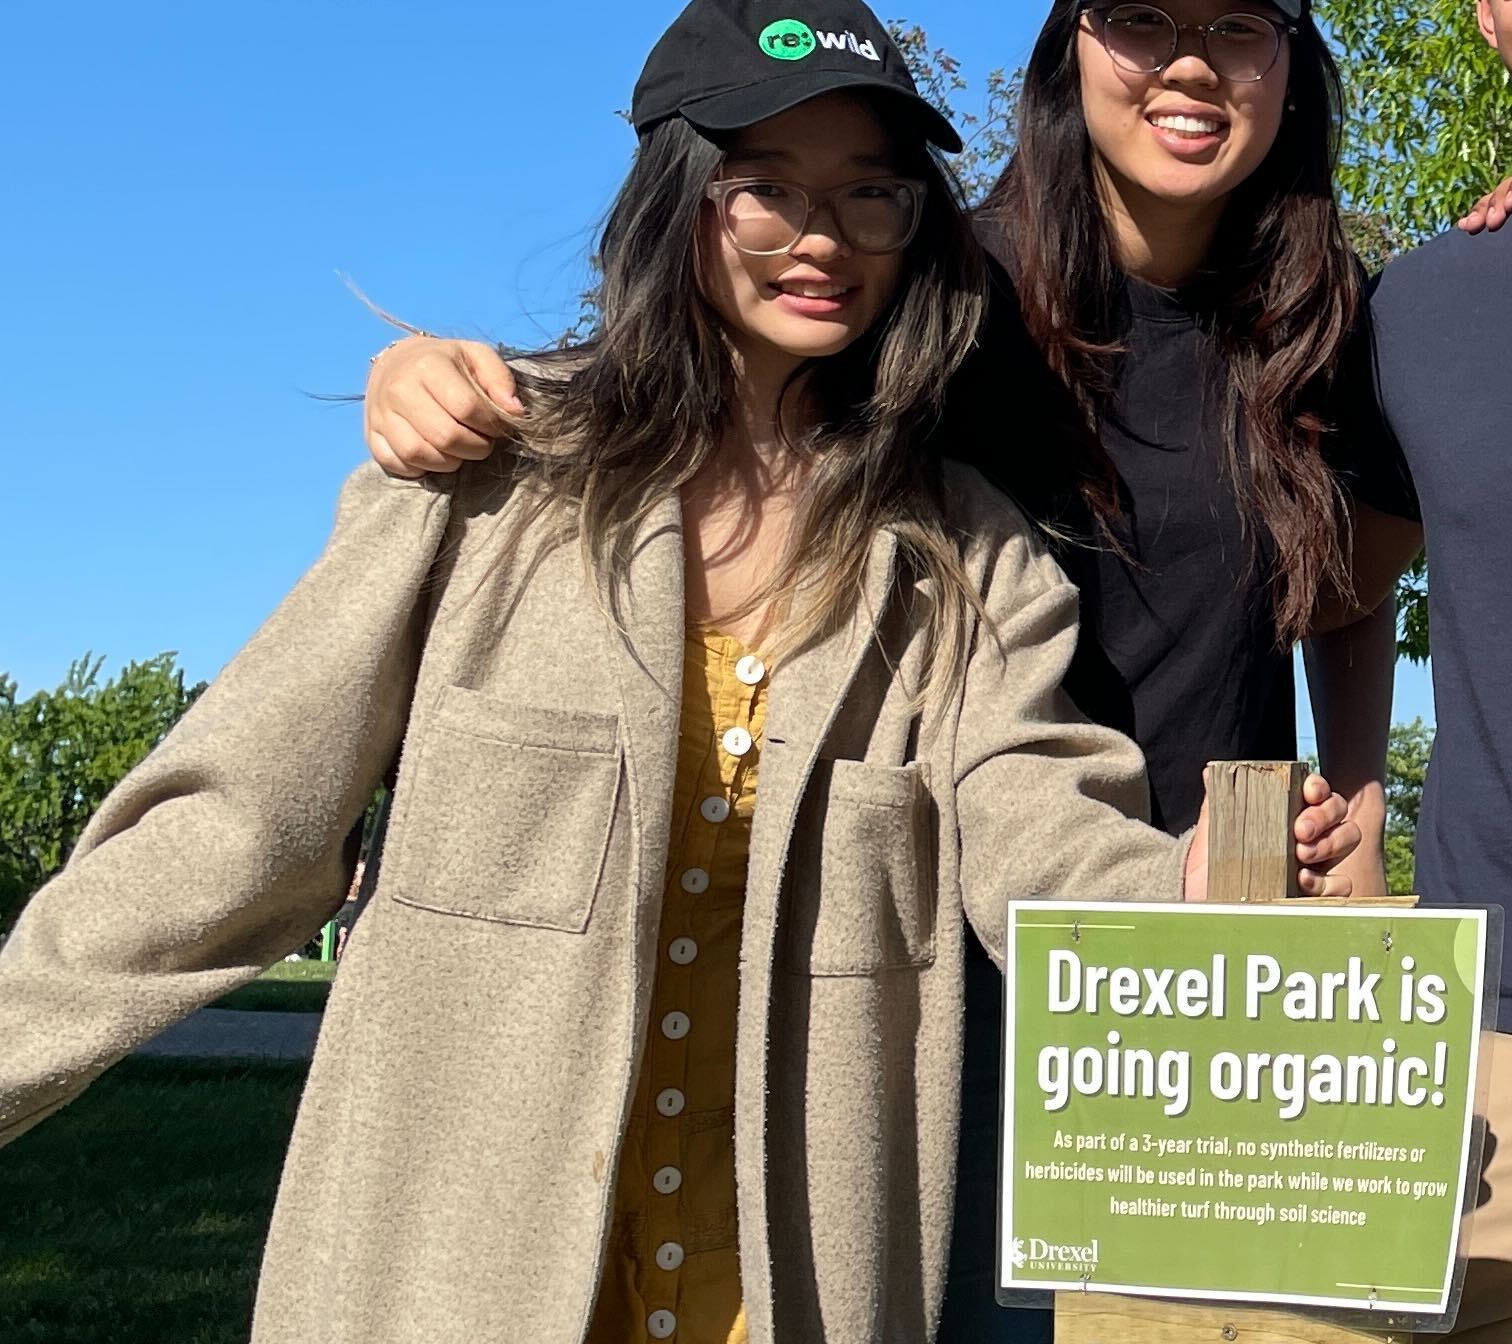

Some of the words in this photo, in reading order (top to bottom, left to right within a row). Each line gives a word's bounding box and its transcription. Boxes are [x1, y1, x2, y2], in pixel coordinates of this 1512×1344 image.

[766, 29, 880, 61] re:wild
[1047, 949, 1224, 1017] Drexel
[1245, 955, 1381, 1021] Park
[1400, 956, 1447, 1023] is
[1037, 1030, 1189, 1116] going
[1209, 1038, 1447, 1118] organic!
[1054, 1130, 1072, 1148] As
[1076, 1133, 1106, 1152] part
[1110, 1133, 1125, 1150] of
[1129, 1137, 1138, 1151] a
[1142, 1134, 1191, 1156] 3-year
[1196, 1136, 1232, 1157] trial,
[1237, 1142, 1256, 1156] no
[1260, 1139, 1333, 1160] synthetic
[1337, 1141, 1407, 1161] fertilizers
[1411, 1148, 1425, 1162] or
[1025, 1161, 1104, 1181] herbicides
[1108, 1164, 1132, 1183] will
[1136, 1166, 1154, 1184] be
[1158, 1168, 1195, 1186] used
[1200, 1168, 1213, 1187] in
[1218, 1169, 1243, 1188] the
[1248, 1171, 1283, 1192] park
[1288, 1172, 1328, 1191] while
[1333, 1178, 1353, 1192] we
[1357, 1176, 1392, 1194] work
[1396, 1178, 1410, 1195] to
[1413, 1182, 1447, 1200] grow
[1110, 1196, 1177, 1217] healthier
[1181, 1201, 1211, 1219] turf
[1215, 1202, 1275, 1225] through
[1279, 1205, 1306, 1223] soil
[1311, 1206, 1366, 1225] science
[1028, 1238, 1099, 1263] Drexel
[1029, 1260, 1097, 1273] UNIVERSITY
